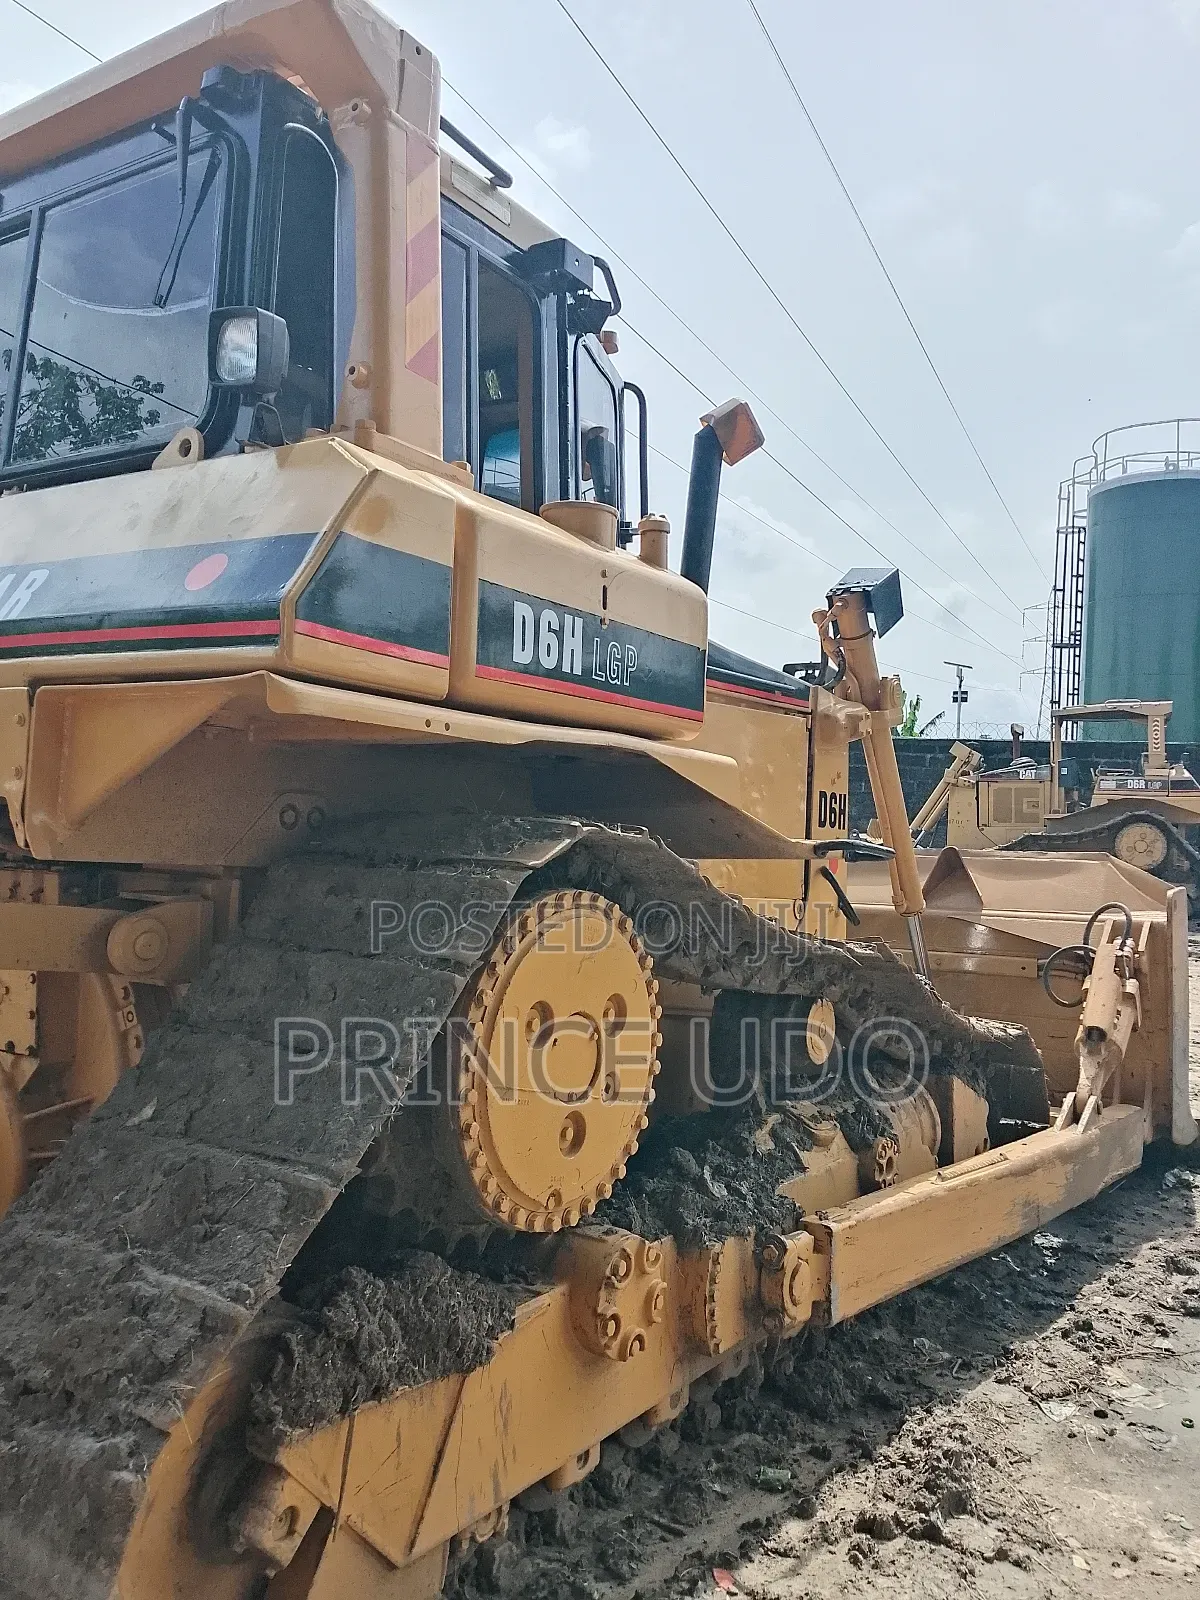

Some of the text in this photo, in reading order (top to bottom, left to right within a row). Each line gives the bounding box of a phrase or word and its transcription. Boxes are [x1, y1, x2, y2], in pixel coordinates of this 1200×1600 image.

[513, 600, 638, 687] D6H LGP
[1019, 769, 1037, 780] CAT
[1127, 779, 1146, 789] D6R
[817, 790, 847, 830] D6H
